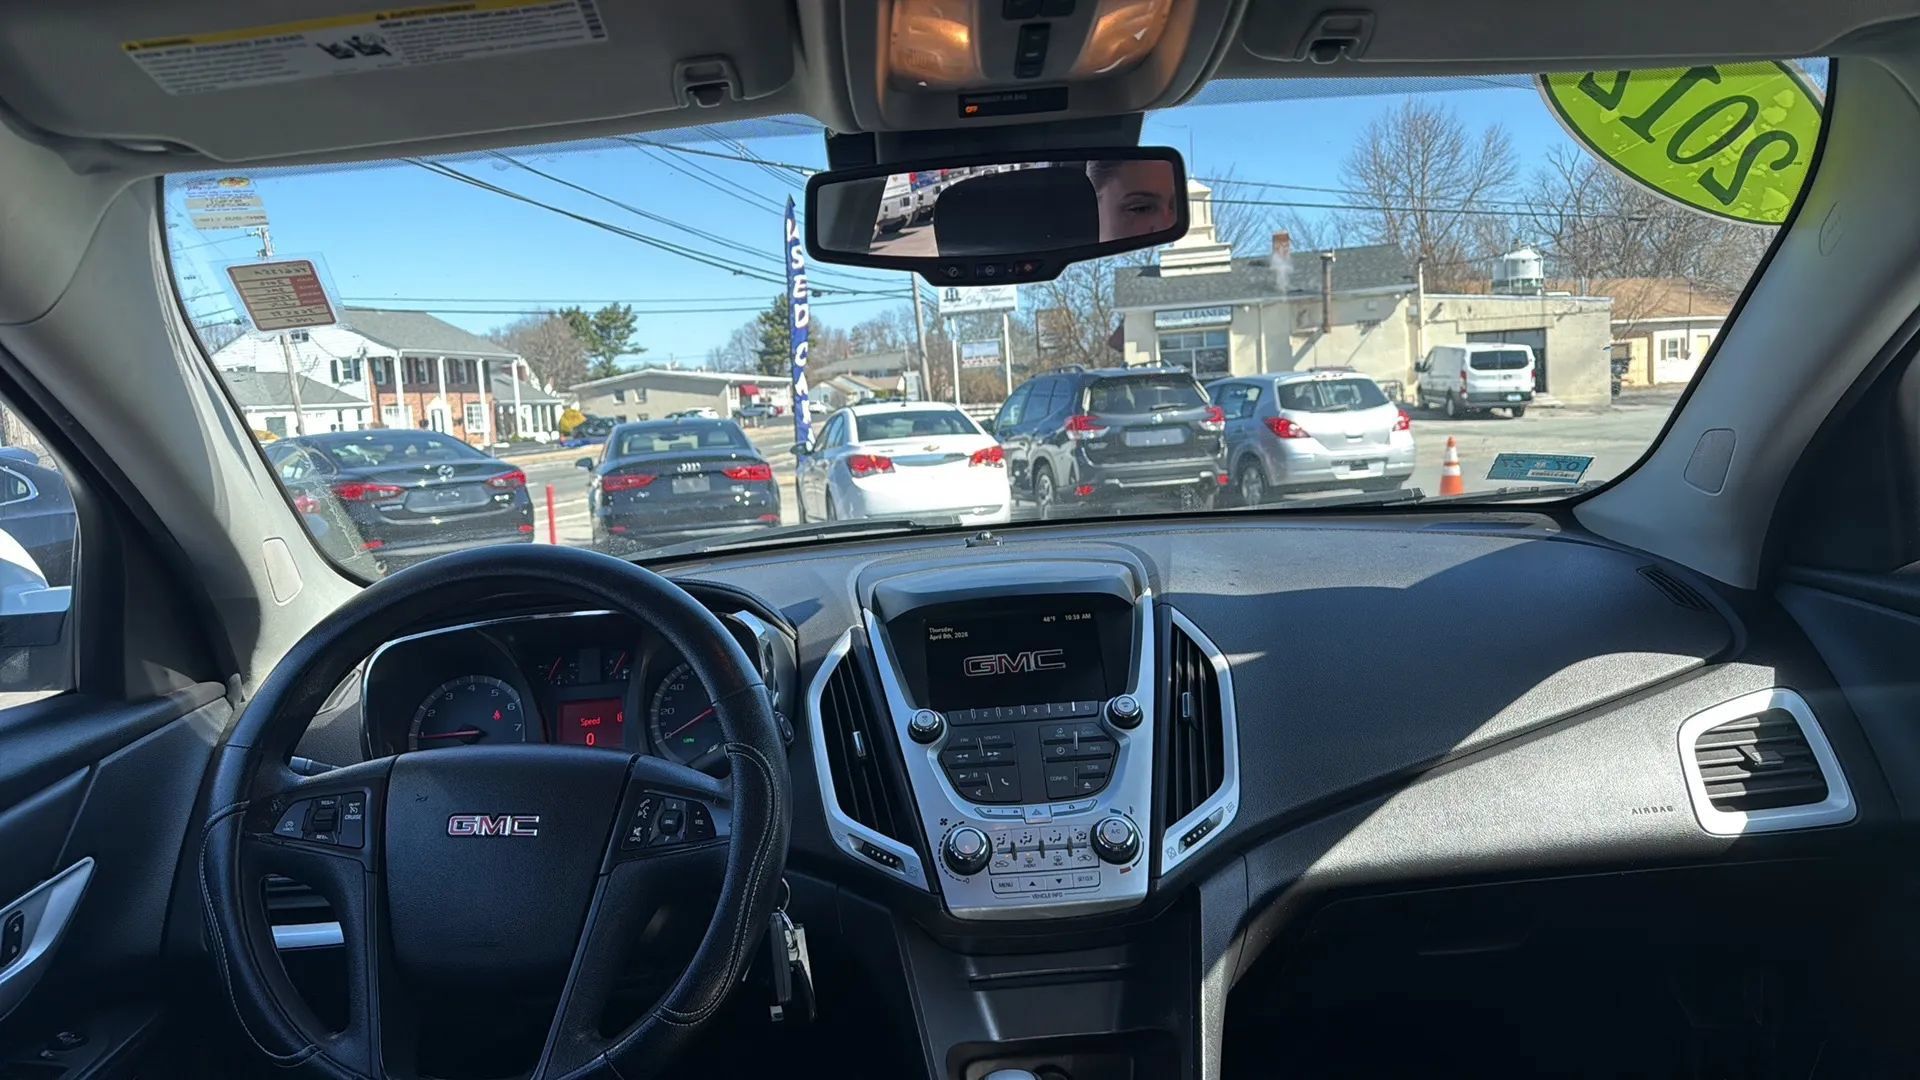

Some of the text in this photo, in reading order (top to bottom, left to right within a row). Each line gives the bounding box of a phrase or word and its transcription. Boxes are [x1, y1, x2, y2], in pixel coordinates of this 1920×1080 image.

[964, 104, 979, 114] OFF
[929, 626, 954, 634] Thursday
[929, 633, 942, 641] April
[963, 649, 1066, 677] GMC
[467, 684, 476, 692] 4
[669, 683, 685, 691] 40
[445, 692, 454, 701] 3
[490, 688, 500, 697] 5
[507, 702, 516, 711] 6
[660, 707, 676, 715] 20
[427, 709, 436, 717] 2
[580, 716, 601, 728] Speed
[513, 723, 522, 732] 7
[585, 732, 595, 746] 0
[1631, 805, 1674, 815] AIRBAG
[448, 815, 540, 836] GMC
[1031, 891, 1063, 900] VEHICLE INFO
